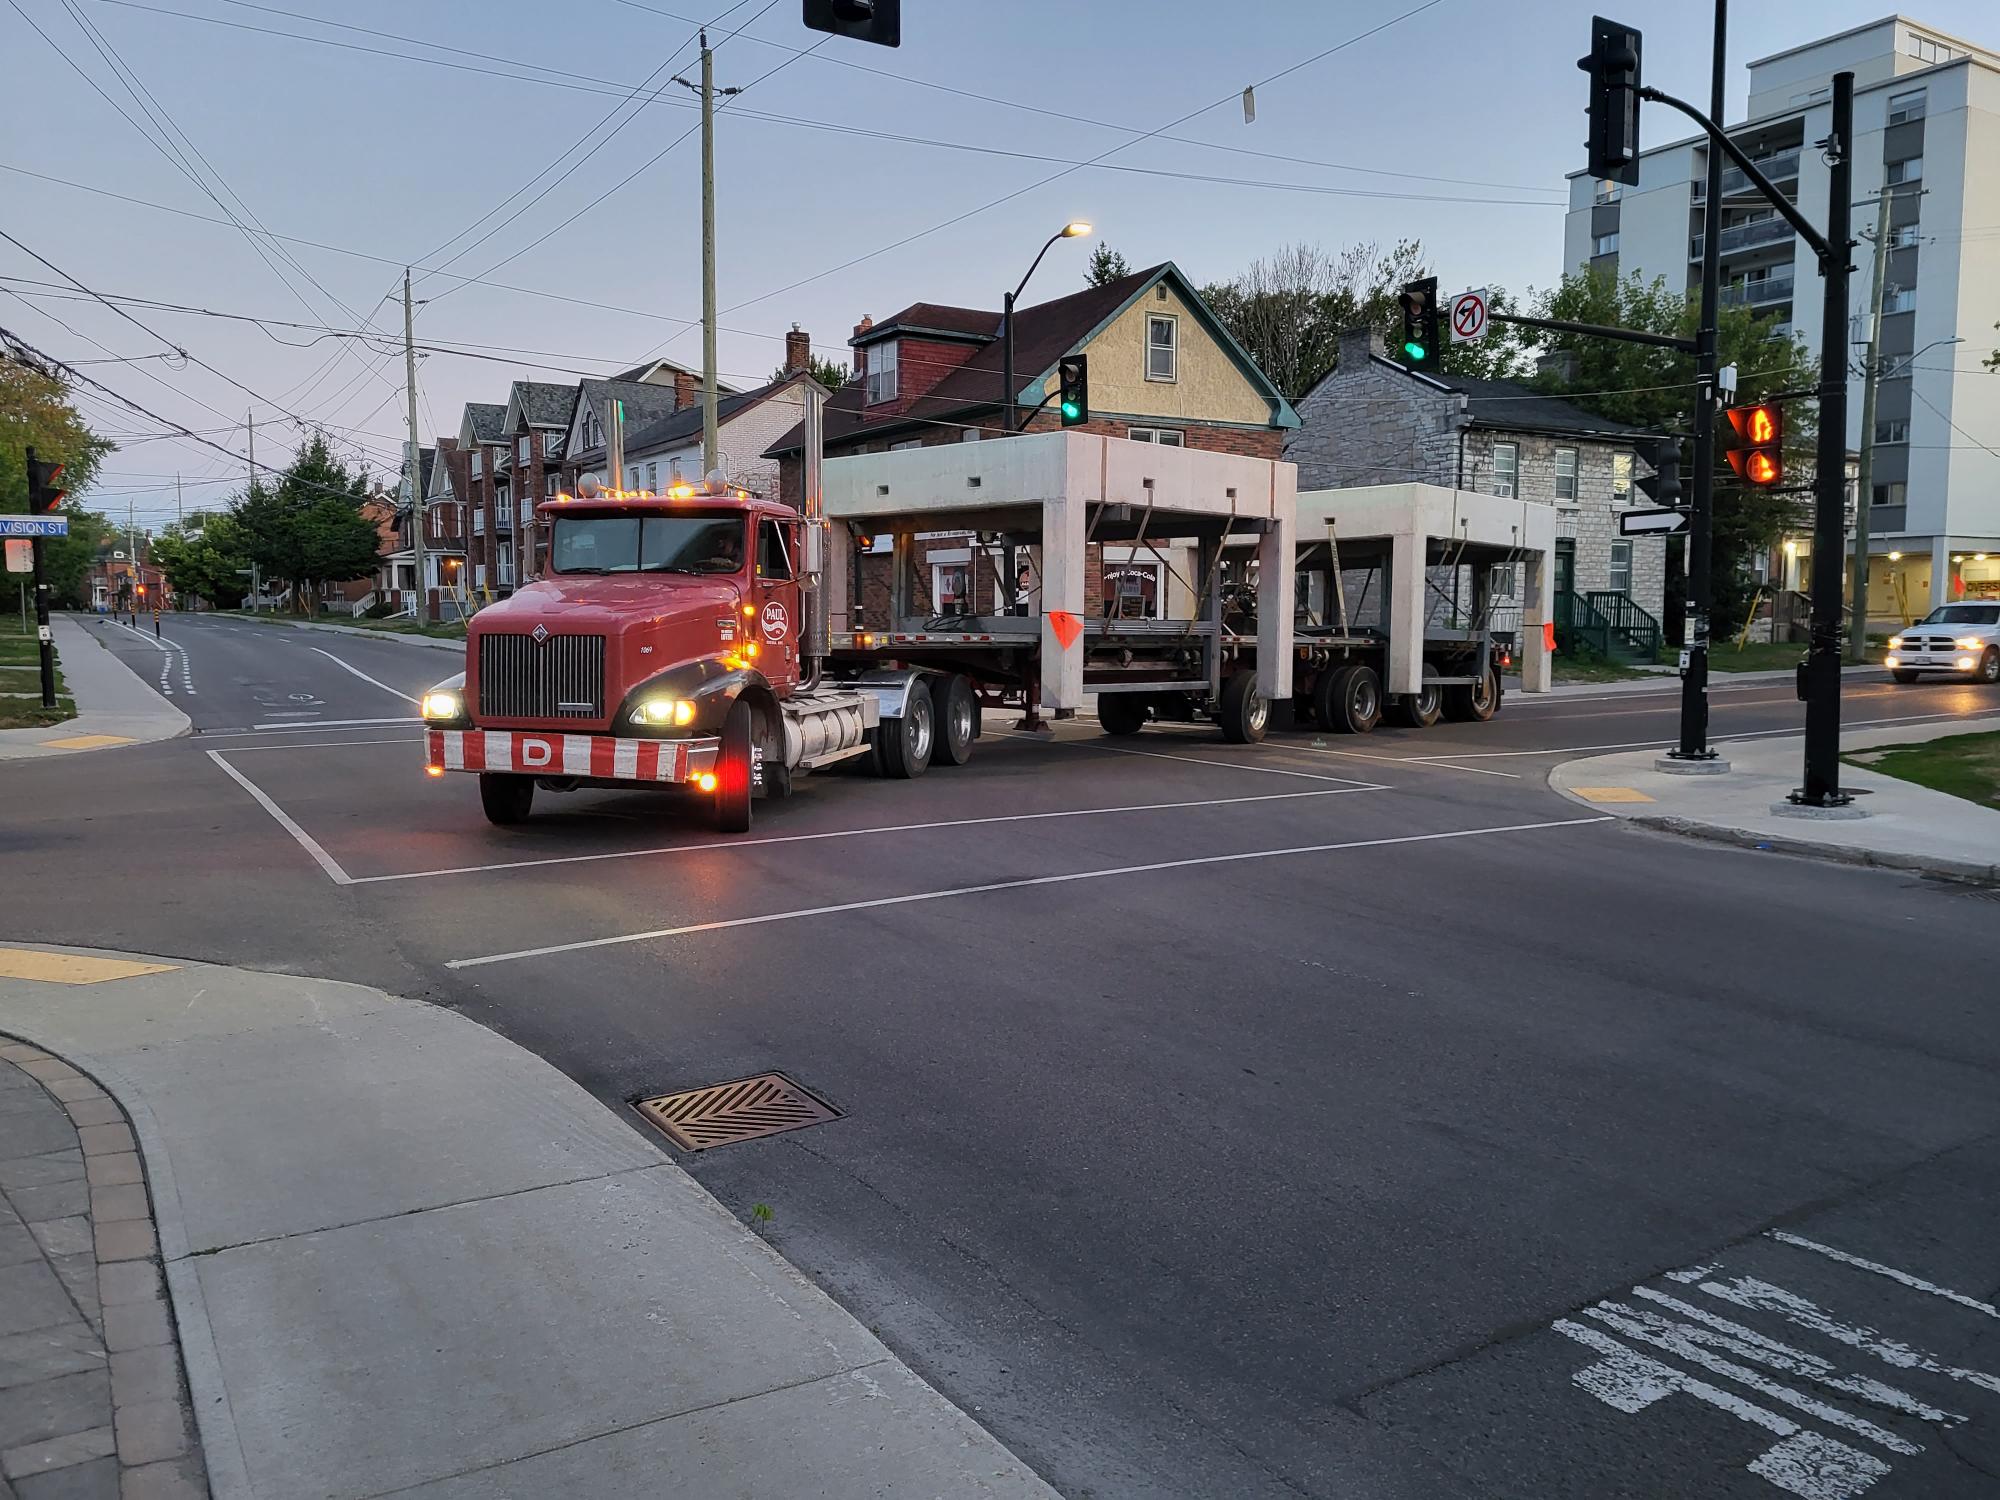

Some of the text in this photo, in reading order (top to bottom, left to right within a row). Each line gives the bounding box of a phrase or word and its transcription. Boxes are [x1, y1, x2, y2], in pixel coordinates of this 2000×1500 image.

[1104, 571, 1120, 580] njoy
[766, 608, 785, 621] PAUL
[522, 738, 552, 766] D
